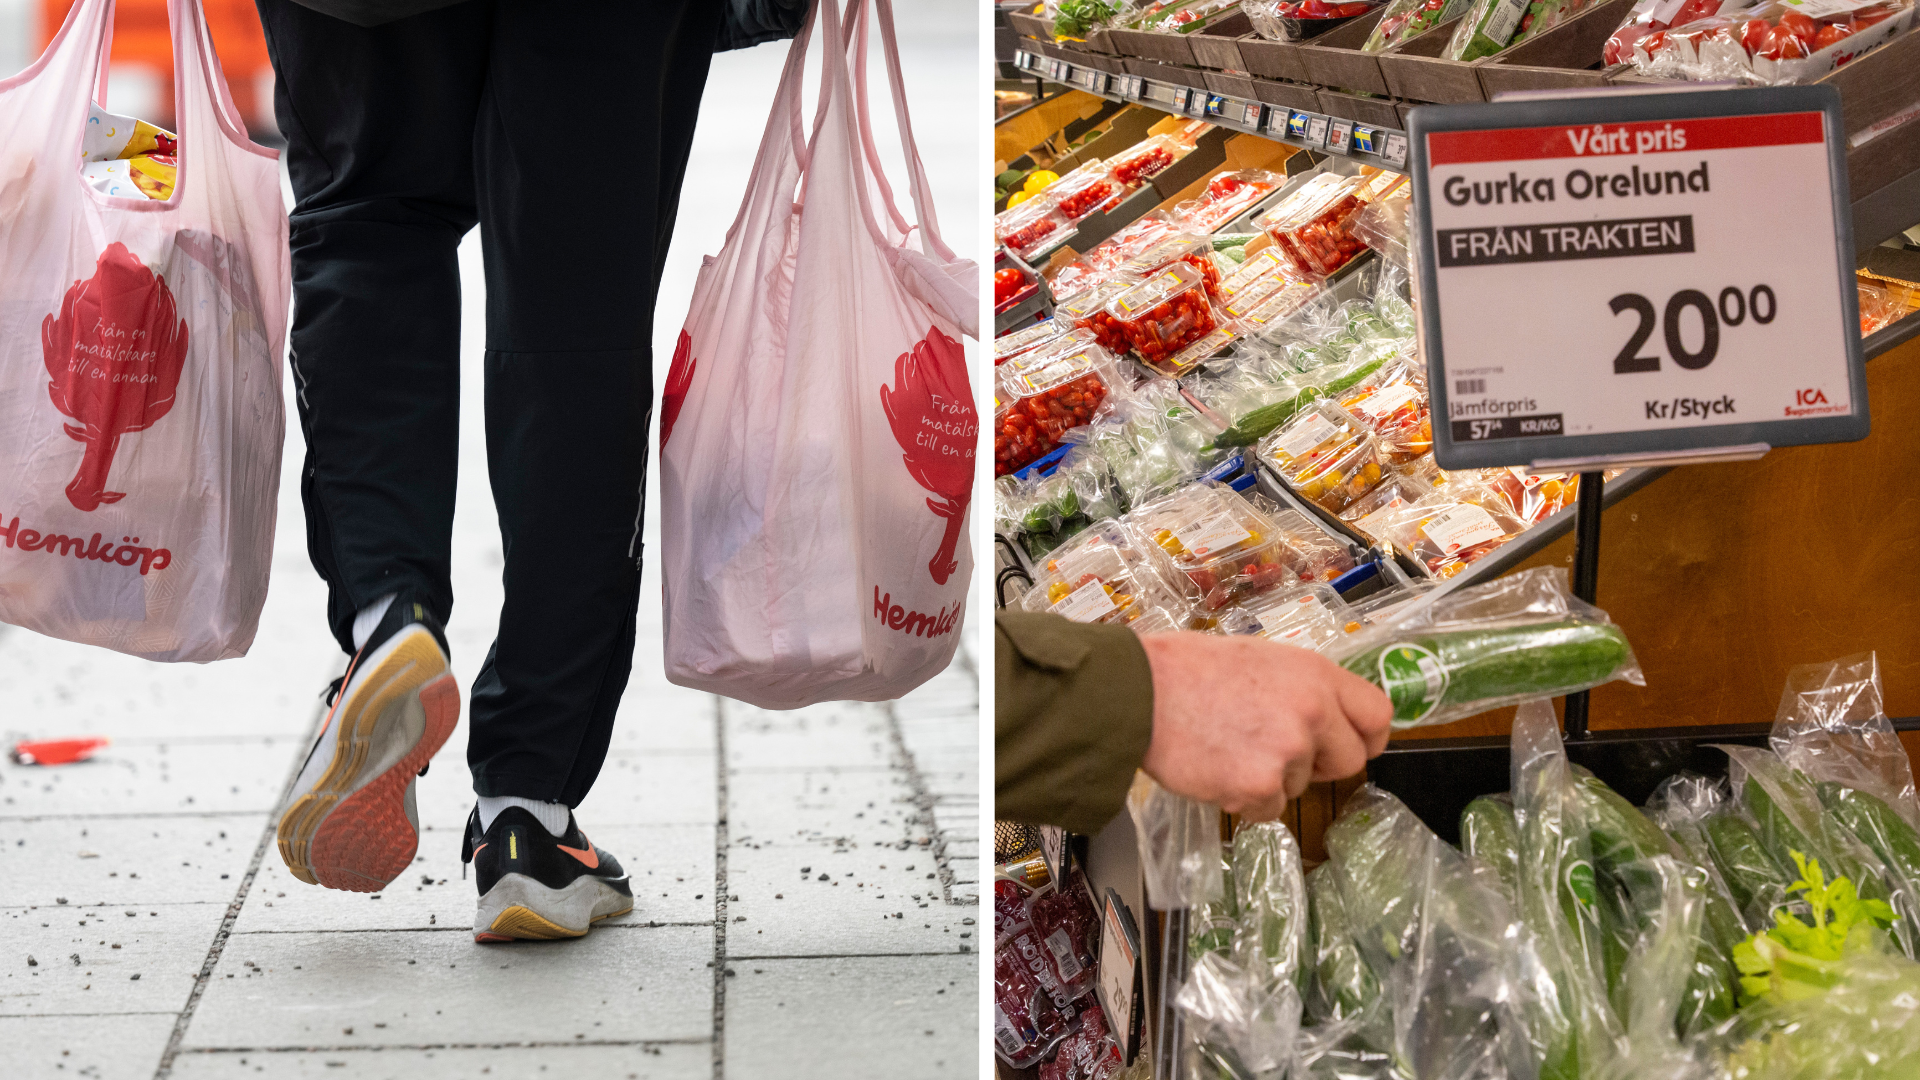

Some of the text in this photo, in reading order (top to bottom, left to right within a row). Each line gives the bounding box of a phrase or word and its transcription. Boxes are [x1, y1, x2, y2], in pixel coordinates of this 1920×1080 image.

[1567, 124, 1687, 155] Vårt pris
[1443, 162, 1710, 206] Gurka Orelund
[1450, 221, 1682, 258] FRÅN TRAKTEN
[132, 329, 145, 340] en
[75, 340, 156, 362] matälskare
[68, 357, 157, 383] till en annan
[931, 394, 971, 415] Från
[1450, 397, 1537, 418] Jämförpris
[1645, 395, 1736, 419] Kr/Styck
[1796, 388, 1828, 405] ICA
[1520, 418, 1560, 433] KR/KG
[917, 431, 938, 451] till
[942, 444, 959, 457] en
[0, 512, 172, 576] Hemköp
[1014, 934, 1076, 1021] RÖDBETOR
